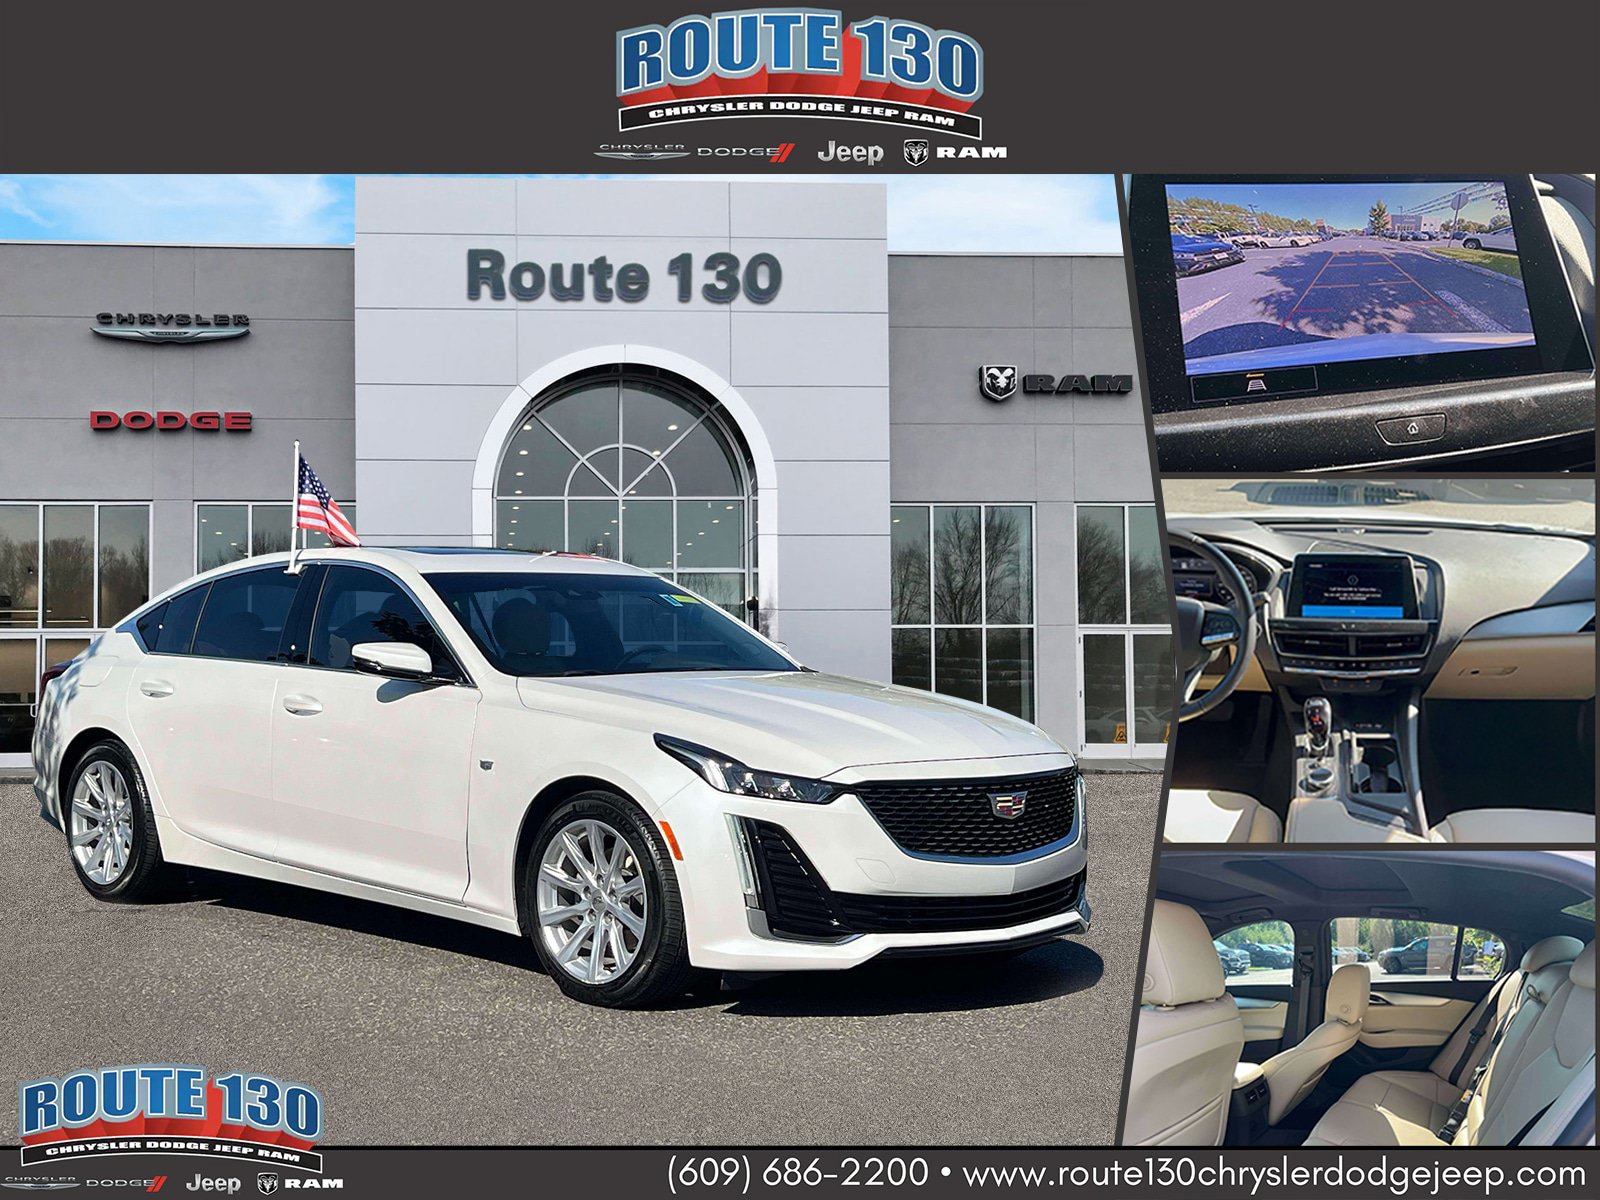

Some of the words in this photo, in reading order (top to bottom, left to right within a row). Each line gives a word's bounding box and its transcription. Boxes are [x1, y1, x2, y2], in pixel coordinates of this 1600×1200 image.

[466, 249, 650, 302] Route
[668, 251, 783, 304] 130
[96, 312, 250, 326] CHRYSLER
[1023, 374, 1133, 394] RAM
[90, 411, 252, 432] DODGE
